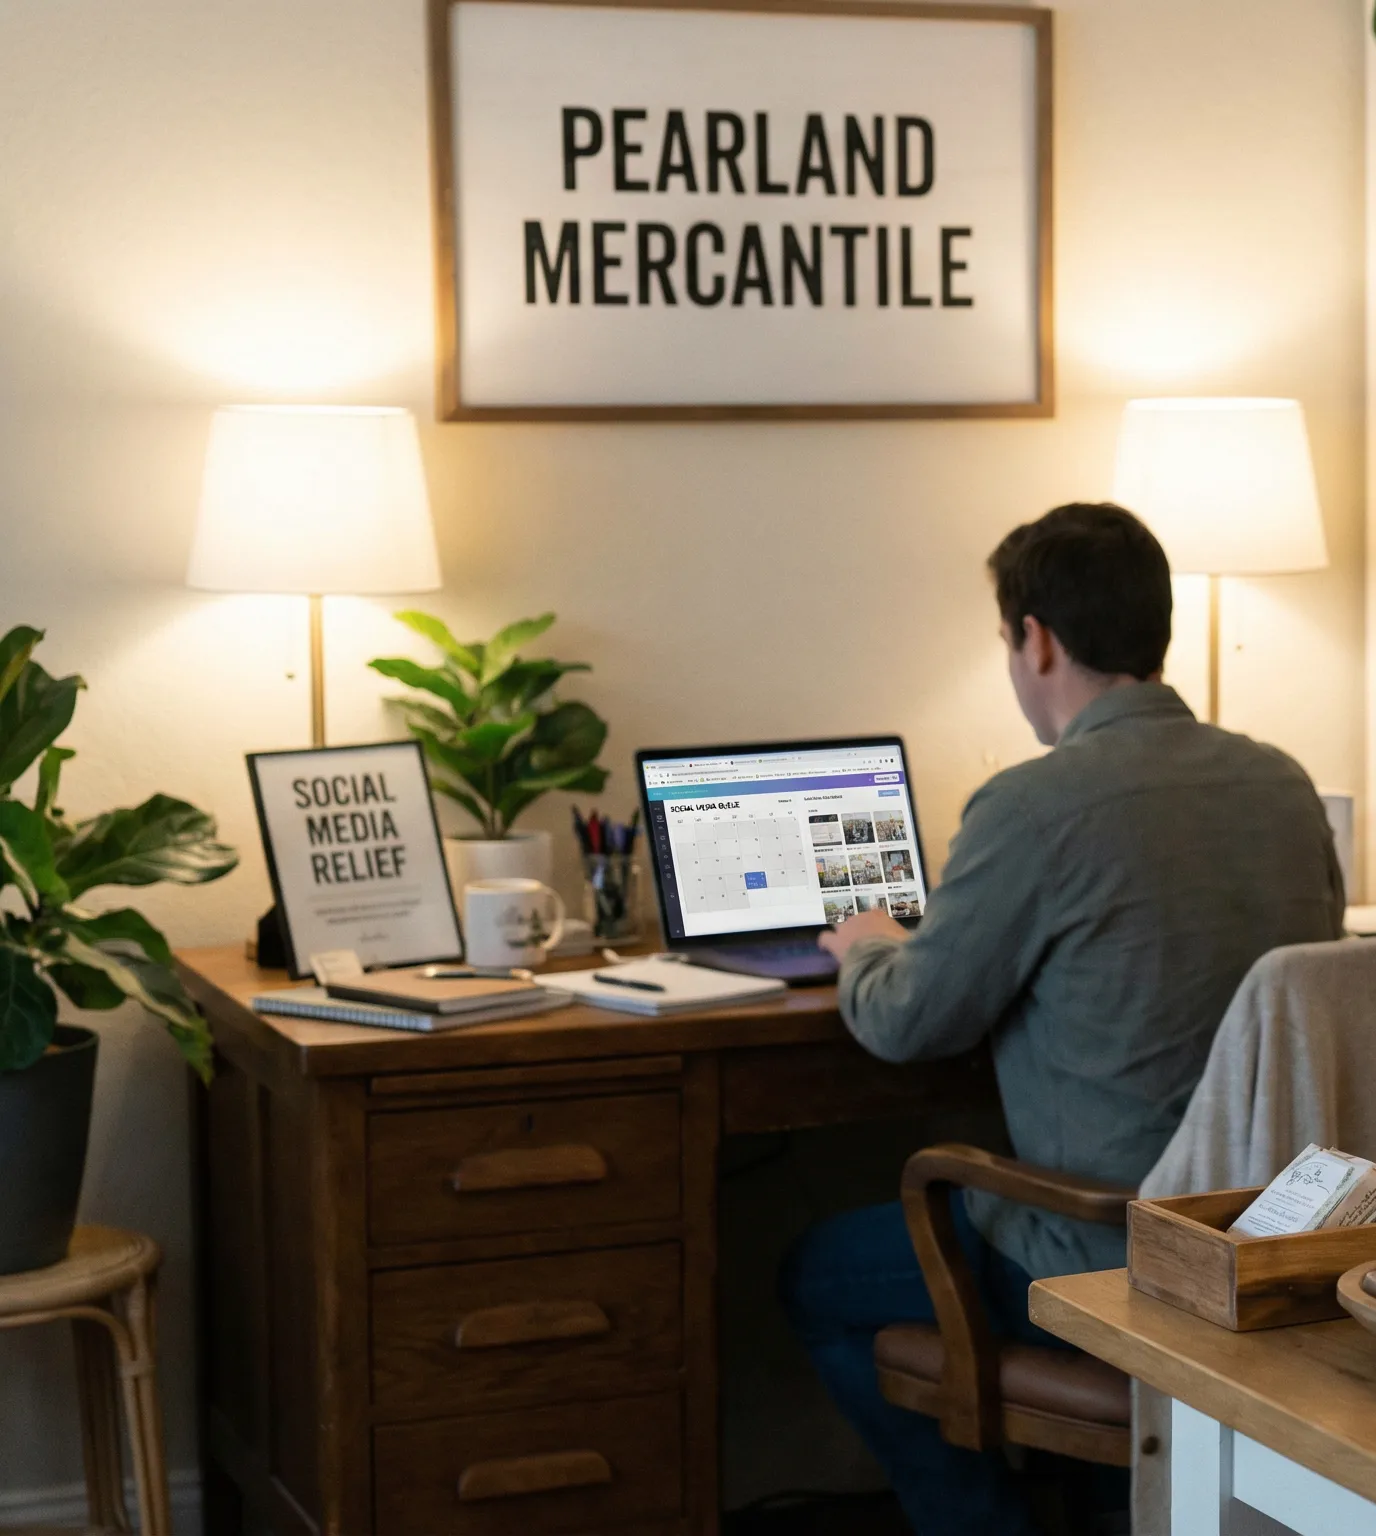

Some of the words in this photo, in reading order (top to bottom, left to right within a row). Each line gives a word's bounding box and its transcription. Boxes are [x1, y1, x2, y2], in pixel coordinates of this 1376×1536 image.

[561, 106, 936, 198] PEARLAND
[523, 220, 974, 309] MERCANTILE
[292, 772, 397, 809] SOCIAL
[305, 809, 399, 846] MEDIA
[310, 845, 406, 885] RELIEF
